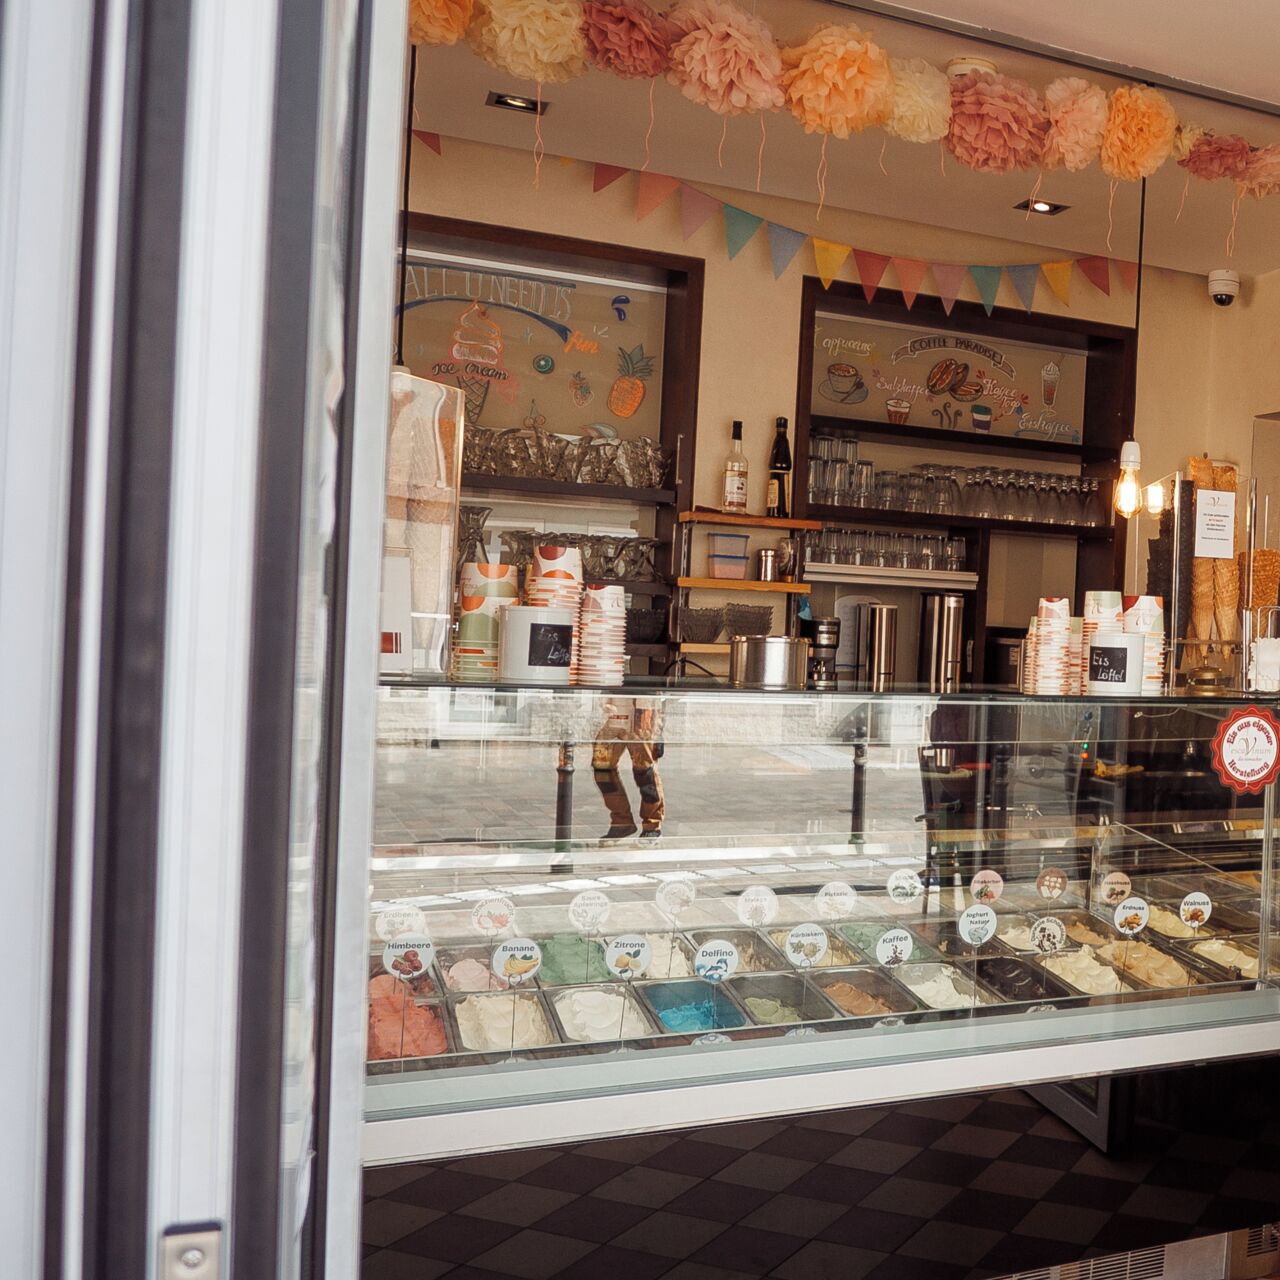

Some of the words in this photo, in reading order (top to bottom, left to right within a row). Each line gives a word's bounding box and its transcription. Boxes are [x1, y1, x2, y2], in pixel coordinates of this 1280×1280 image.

[1092, 650, 1110, 667] Eis
[1226, 730, 1238, 745] Eis
[1237, 721, 1252, 733] aus
[1228, 759, 1270, 778] Herstellung
[882, 935, 909, 945] Kaffee
[388, 941, 431, 950] Himbeere
[501, 944, 535, 953] Banane
[614, 941, 646, 950] Zitrone
[701, 949, 734, 959] Delfino
